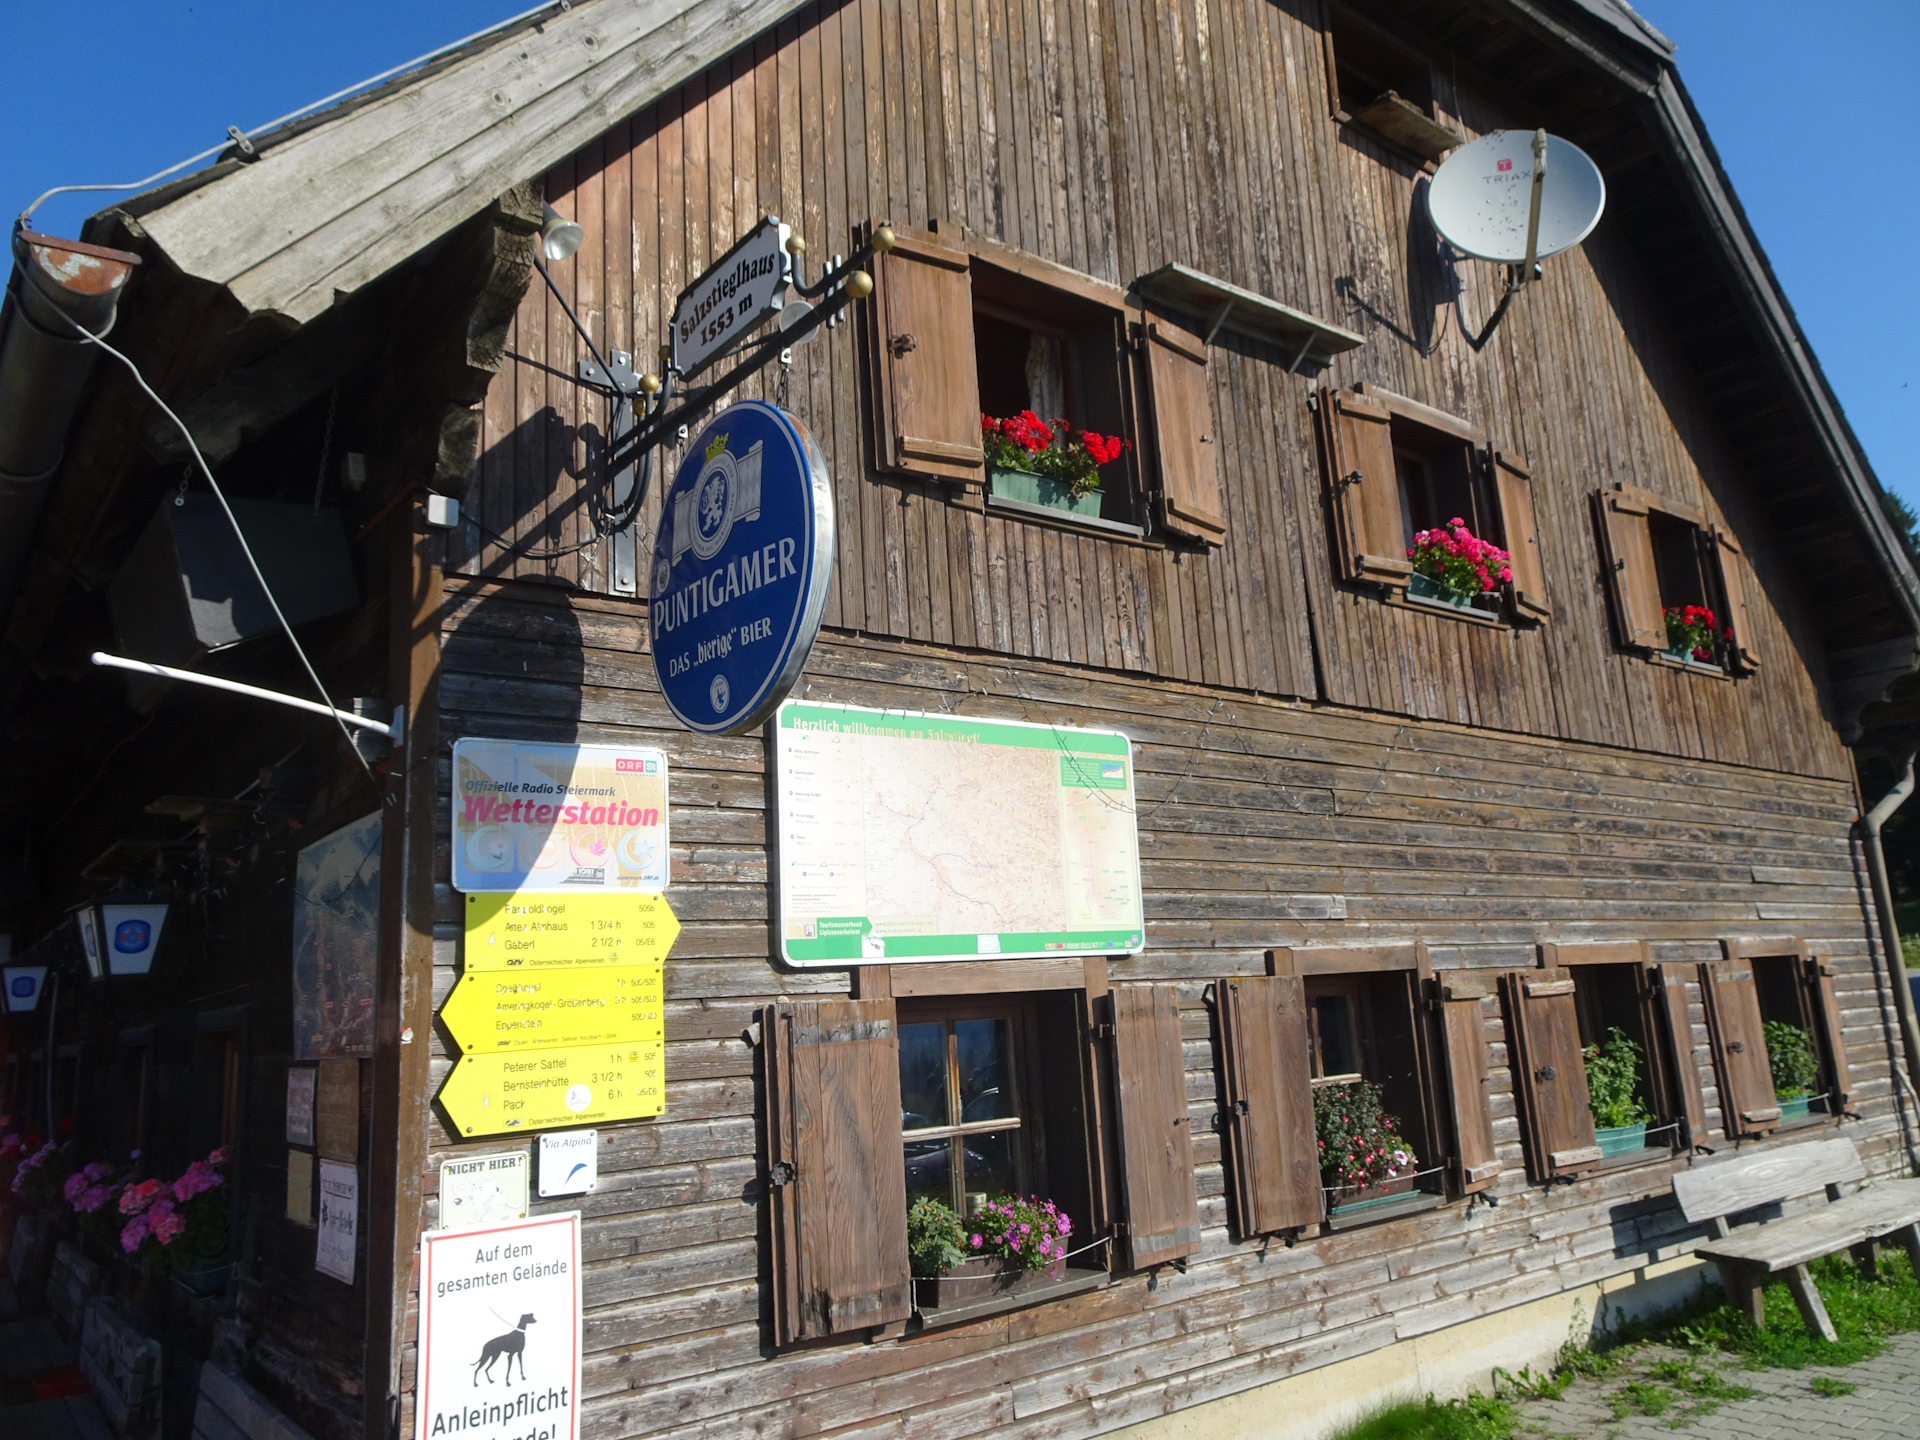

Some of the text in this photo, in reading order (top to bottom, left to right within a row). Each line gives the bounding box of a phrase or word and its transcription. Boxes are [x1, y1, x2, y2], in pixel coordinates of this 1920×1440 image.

[1482, 170, 1532, 184] TRIAX
[680, 253, 774, 344] Salzstieglhaus
[700, 292, 753, 346] 1553 m
[654, 536, 797, 640] PUNTIGAMER
[670, 652, 690, 678] DAS
[740, 617, 772, 646] BIER
[794, 717, 839, 732] Herzlich
[842, 722, 906, 738] willkommen
[910, 729, 924, 740] am
[617, 761, 656, 770] ORF St
[466, 780, 616, 796] Offizielle Radio Steiermark
[464, 796, 658, 826] Wetterstation
[597, 921, 612, 930] 3/4
[616, 920, 621, 929] h
[505, 940, 535, 950] Gaberl
[592, 938, 597, 947] 2
[601, 938, 613, 947] 1/2
[503, 1061, 538, 1072] Peterer
[541, 1059, 566, 1070] Sattel
[610, 1054, 614, 1063] 1
[616, 1054, 622, 1063] h
[503, 1077, 569, 1092] Bernsteinhütte
[592, 1073, 598, 1083] 3
[601, 1072, 614, 1081] 1/2
[616, 1072, 622, 1081] h
[503, 1099, 526, 1110] Pack
[608, 1090, 614, 1100] 6
[617, 1089, 622, 1098] h
[544, 1138, 592, 1149] Via Alpina
[448, 1162, 485, 1176] NICHT
[475, 1244, 532, 1264] Auf dem
[437, 1259, 567, 1298] gesamten Gelände
[432, 1386, 568, 1437] Anleinpflicht
